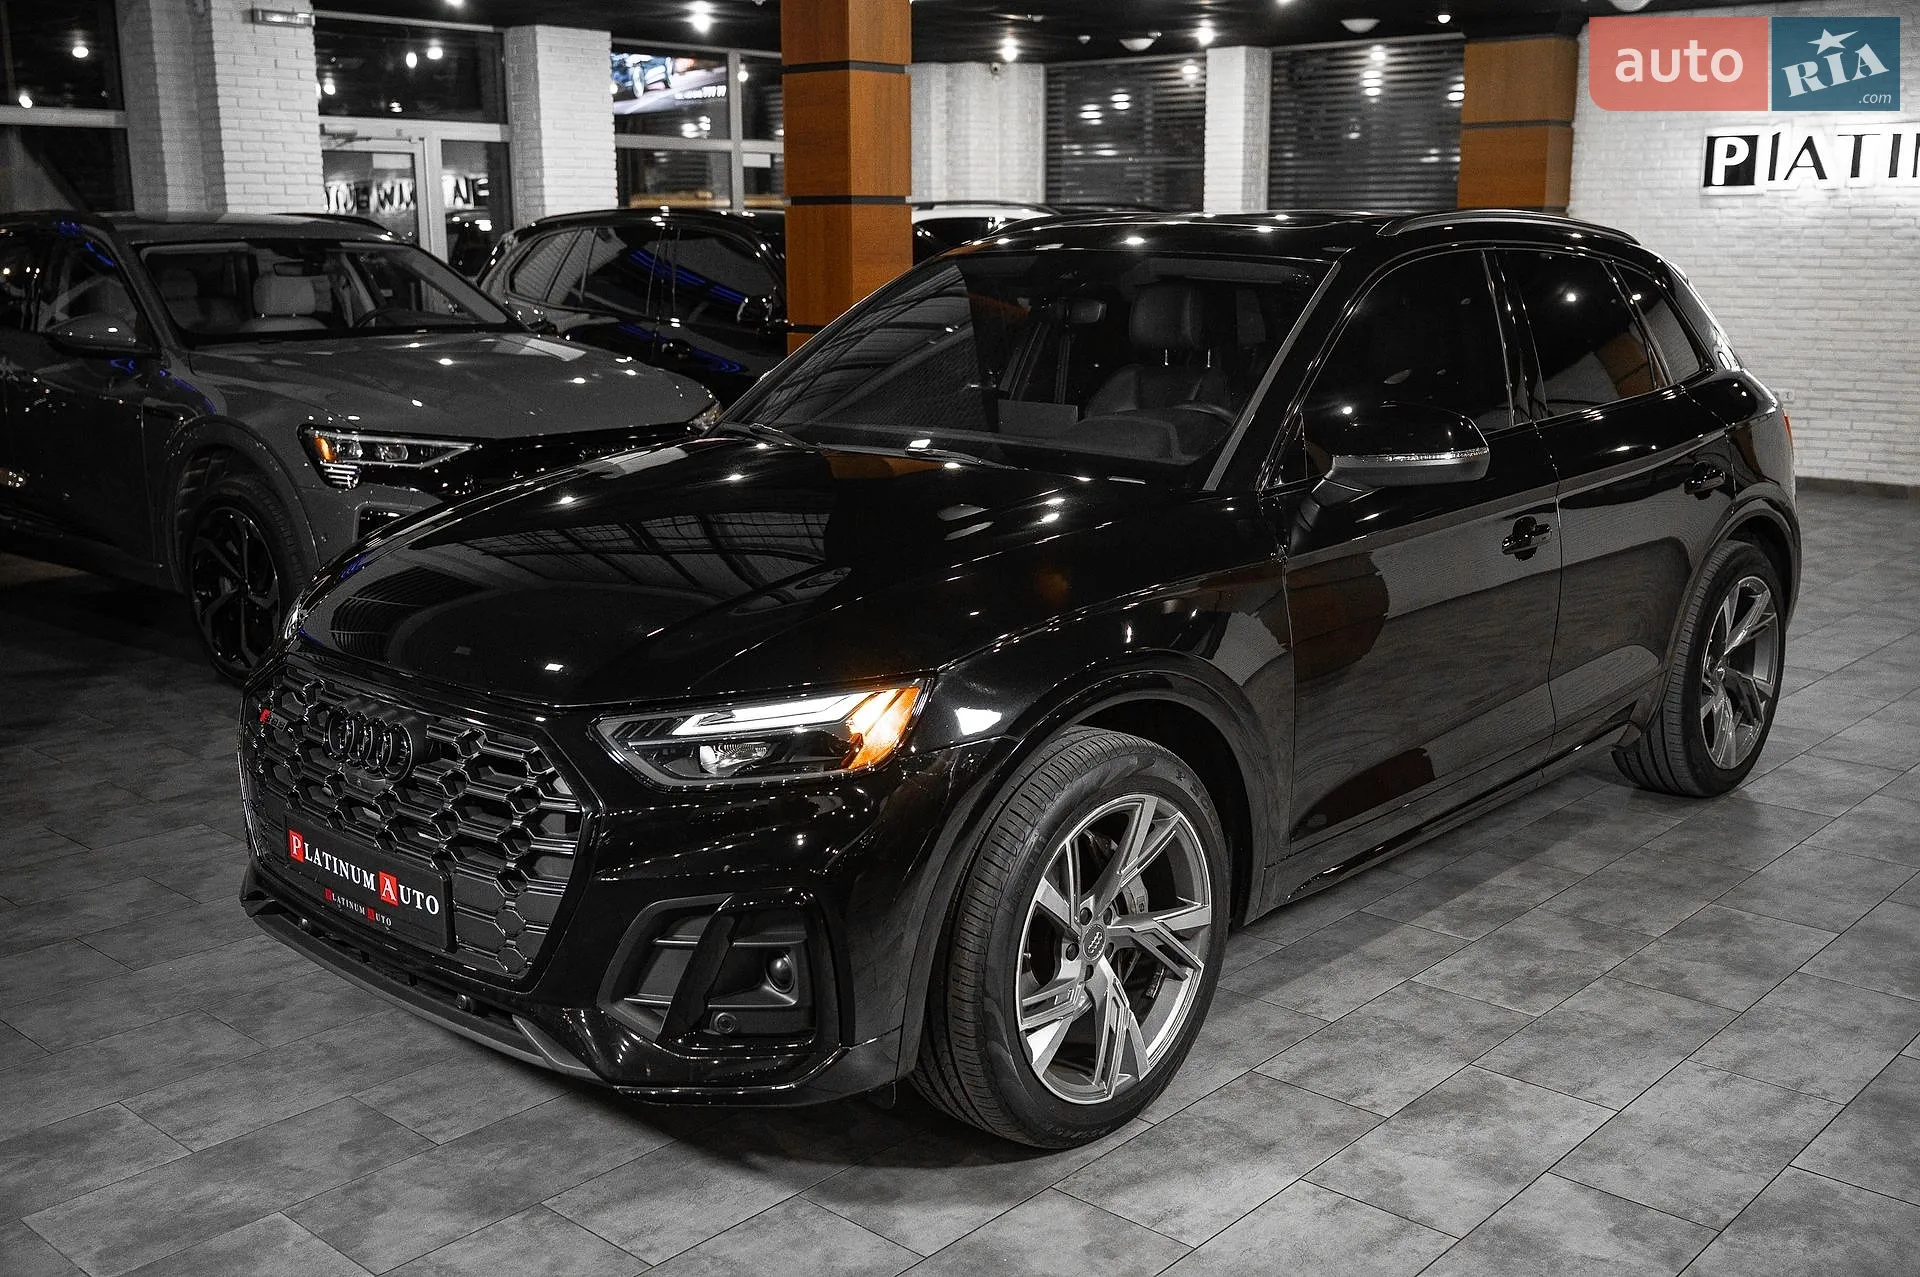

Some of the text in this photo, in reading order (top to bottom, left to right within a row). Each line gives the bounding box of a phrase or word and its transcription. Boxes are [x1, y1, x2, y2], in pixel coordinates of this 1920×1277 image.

[290, 835, 440, 915] PLATINUM AUTO
[325, 888, 392, 926] LATINUM UTO
